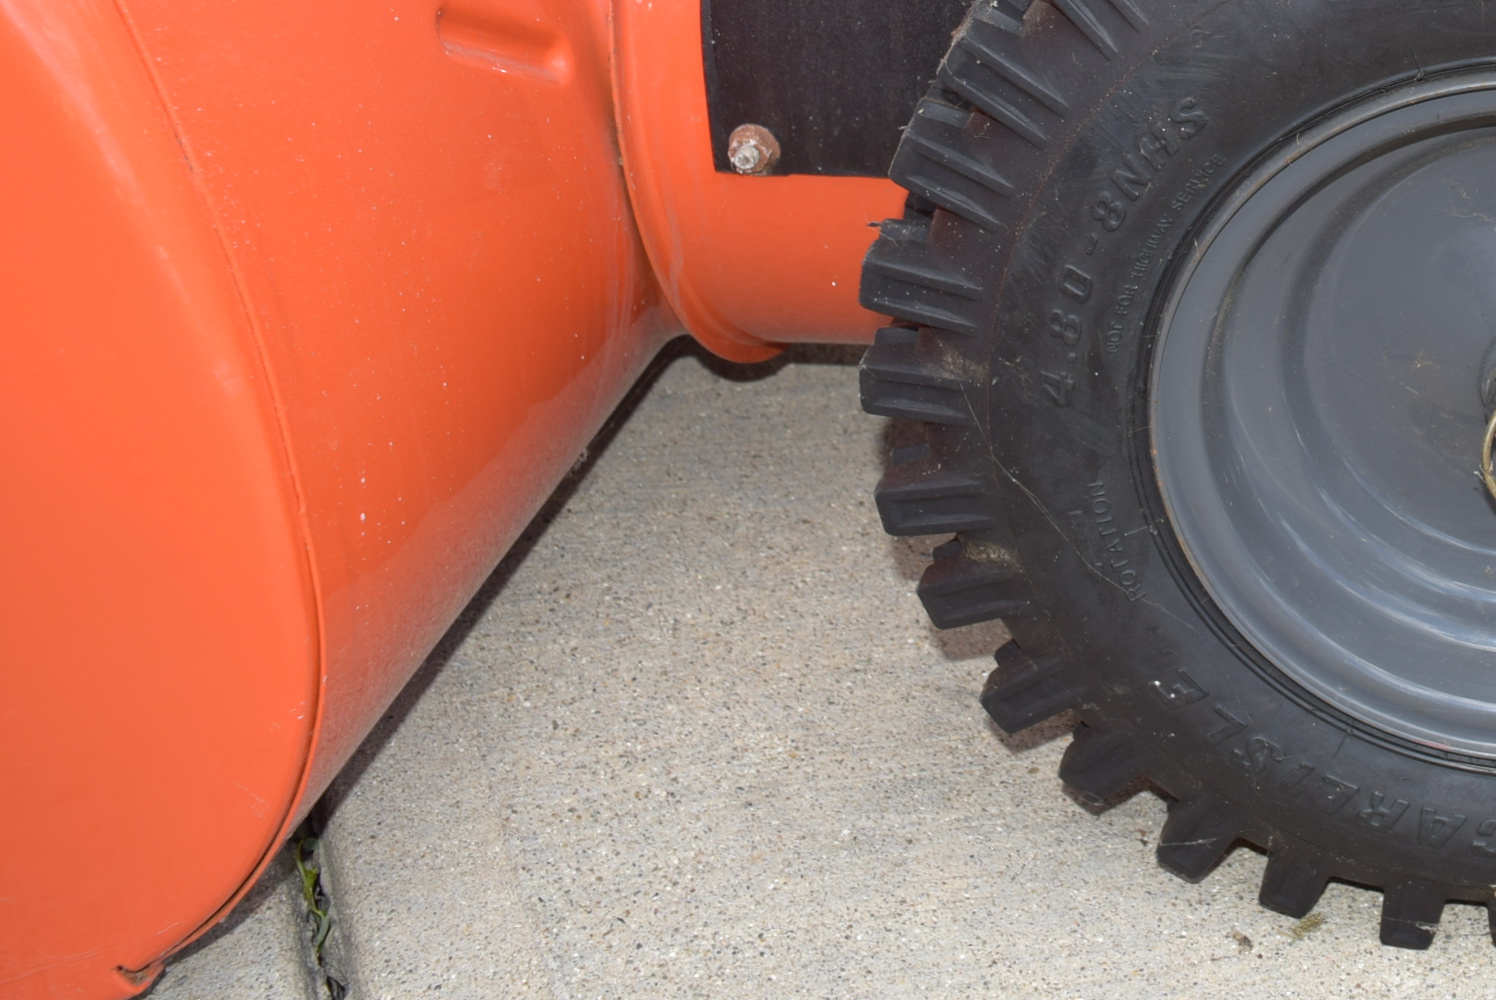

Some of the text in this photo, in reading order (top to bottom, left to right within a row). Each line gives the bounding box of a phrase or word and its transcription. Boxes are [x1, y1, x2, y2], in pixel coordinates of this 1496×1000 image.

[1106, 153, 1227, 353] NOT FOR HIGHWAY SERVICE
[1086, 481, 1146, 602] ROTATION
